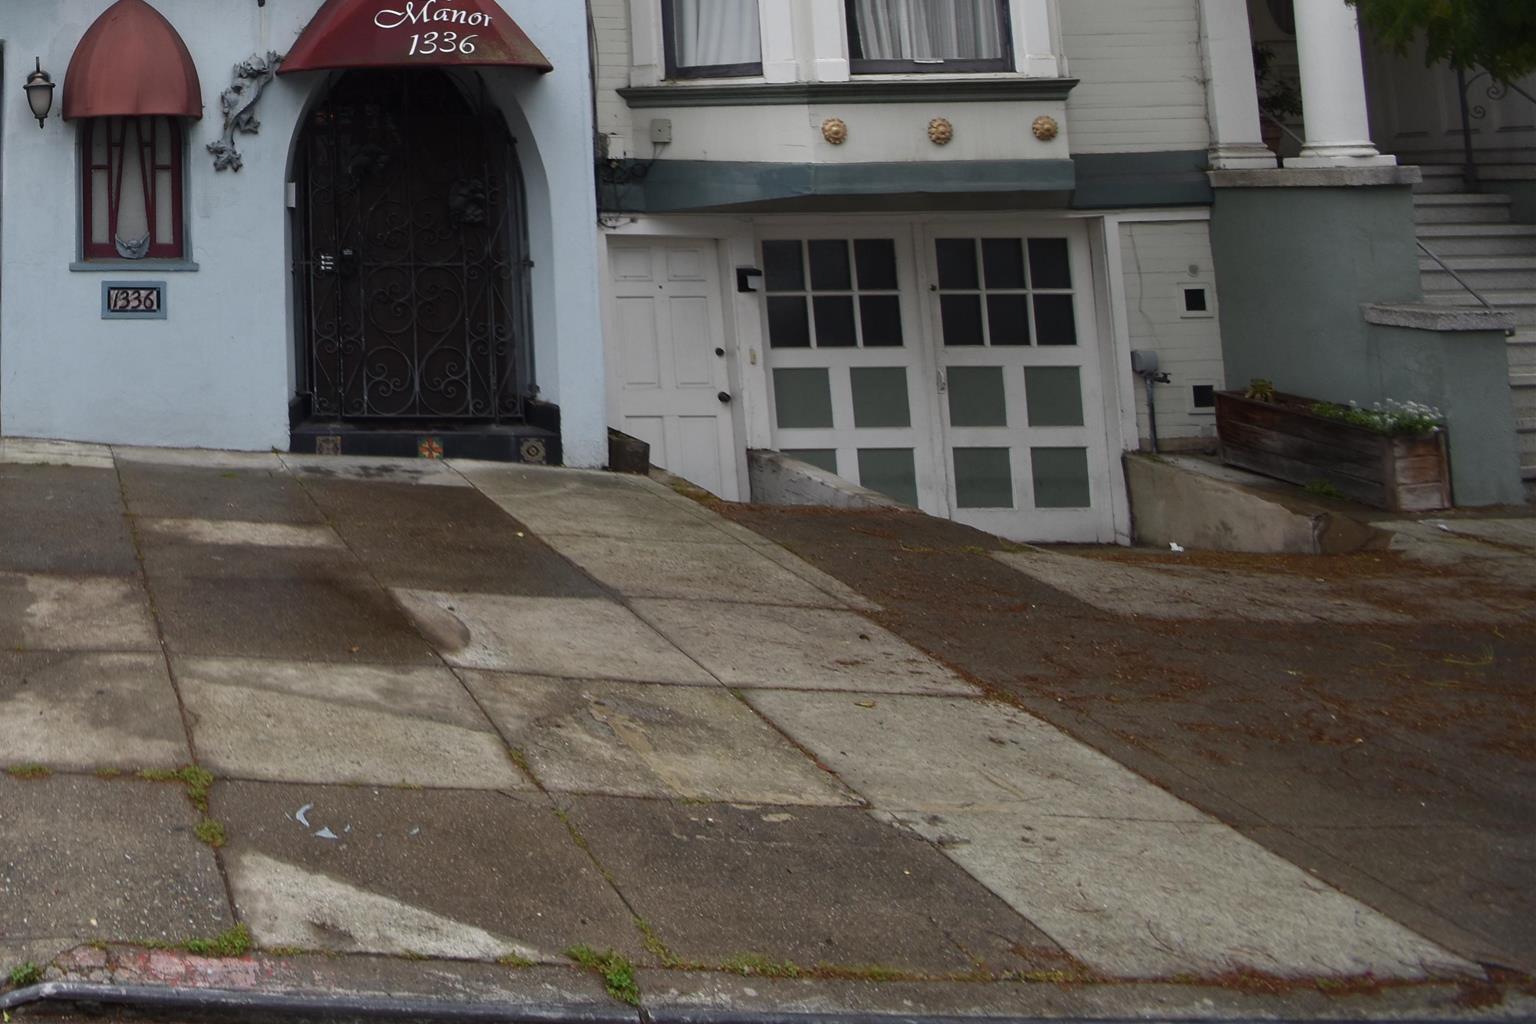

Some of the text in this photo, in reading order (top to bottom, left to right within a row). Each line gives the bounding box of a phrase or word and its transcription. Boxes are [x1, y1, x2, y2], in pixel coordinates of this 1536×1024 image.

[374, 0, 494, 29] Manor
[408, 31, 480, 56] 1336
[113, 289, 155, 311] 1336
